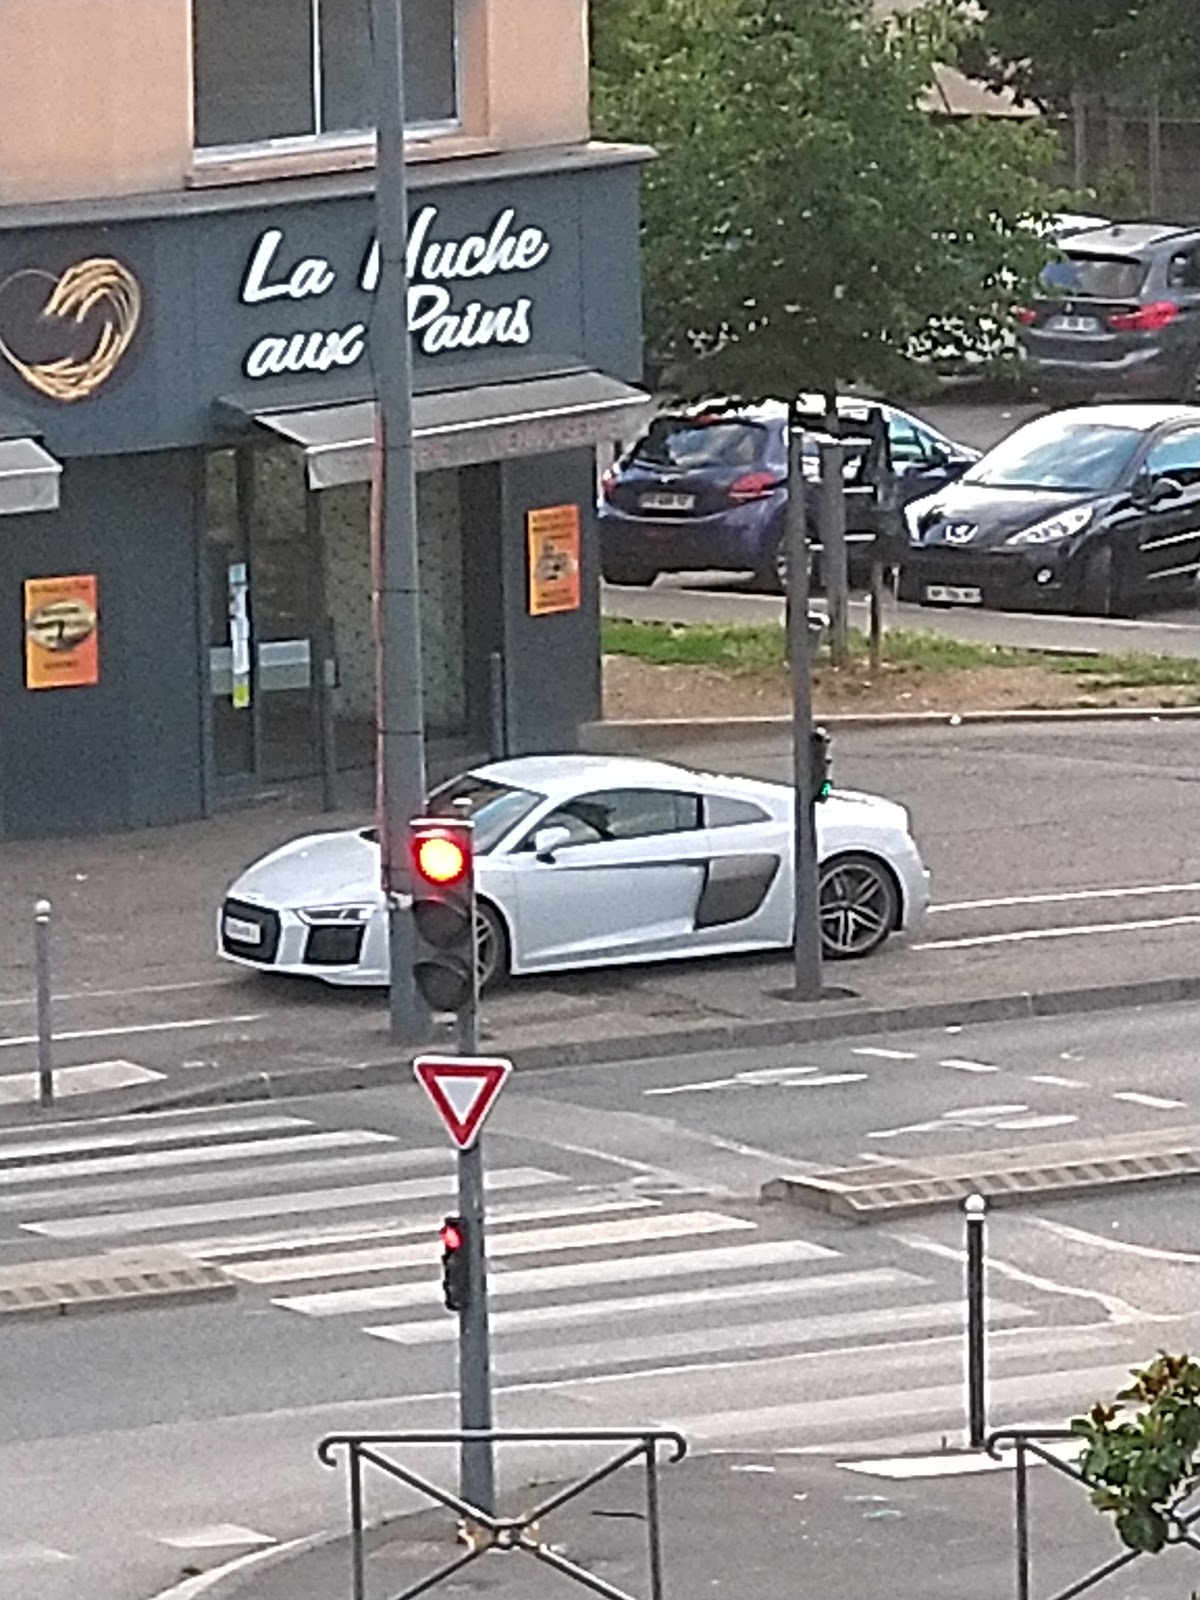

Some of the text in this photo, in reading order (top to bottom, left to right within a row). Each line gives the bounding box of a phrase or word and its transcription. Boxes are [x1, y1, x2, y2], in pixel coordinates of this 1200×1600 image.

[242, 229, 336, 303] La
[246, 283, 532, 377] aux Pains
